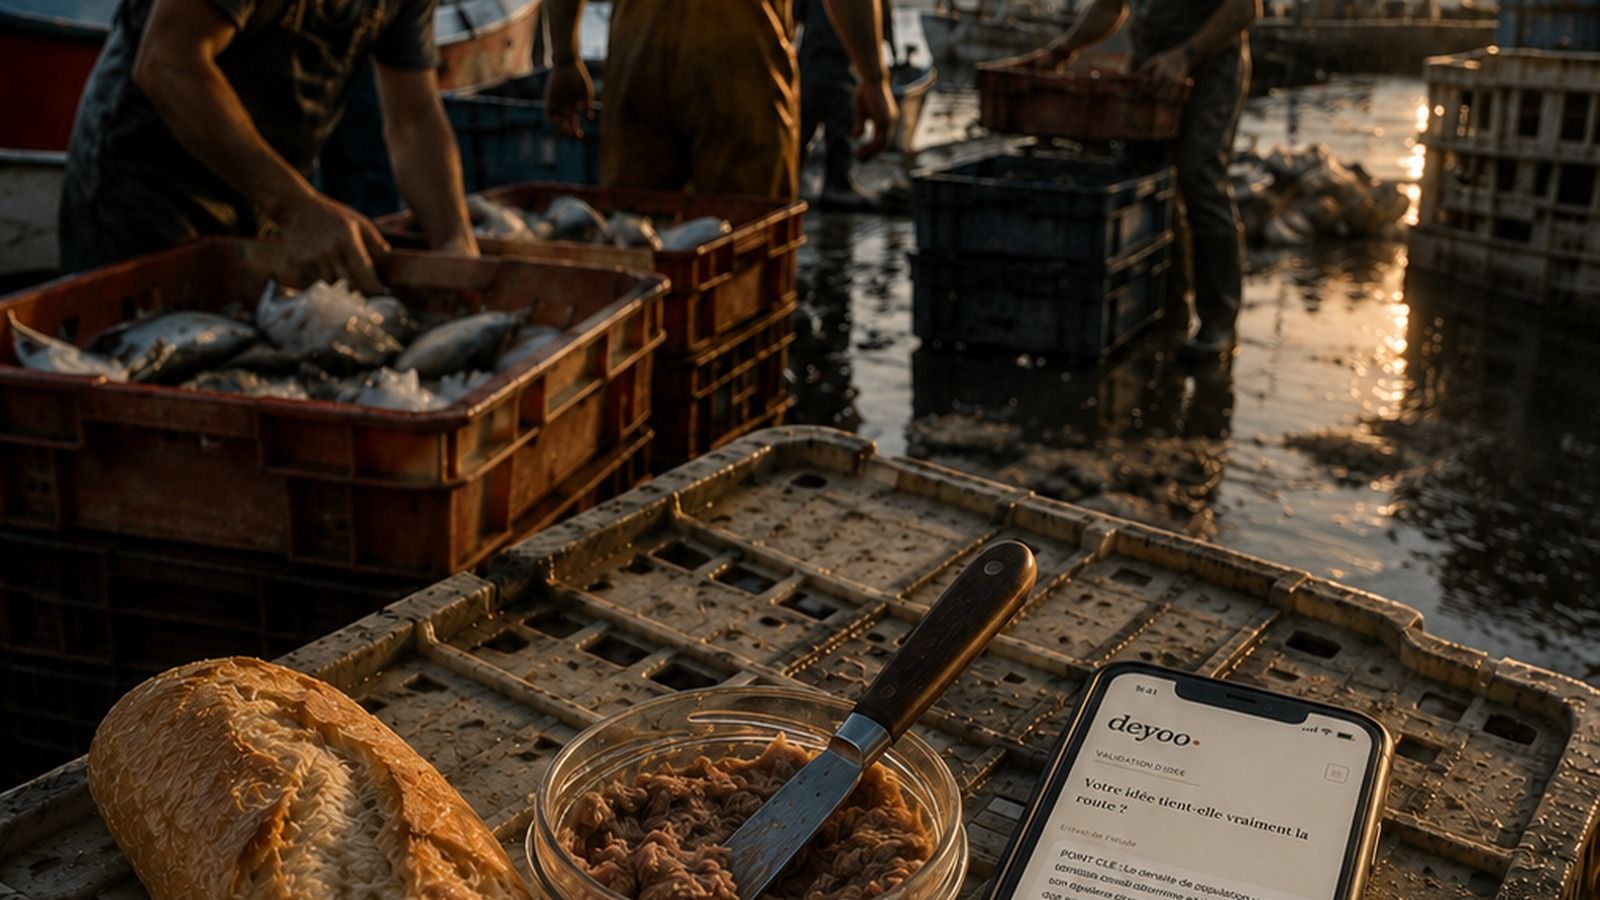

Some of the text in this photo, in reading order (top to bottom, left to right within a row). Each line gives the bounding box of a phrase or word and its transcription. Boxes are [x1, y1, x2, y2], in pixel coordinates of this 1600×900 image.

[1096, 750, 1153, 768] VALIDATION
[1076, 795, 1128, 814] route ?
[1085, 777, 1309, 841] Votre idée tient-elle vraiment la
